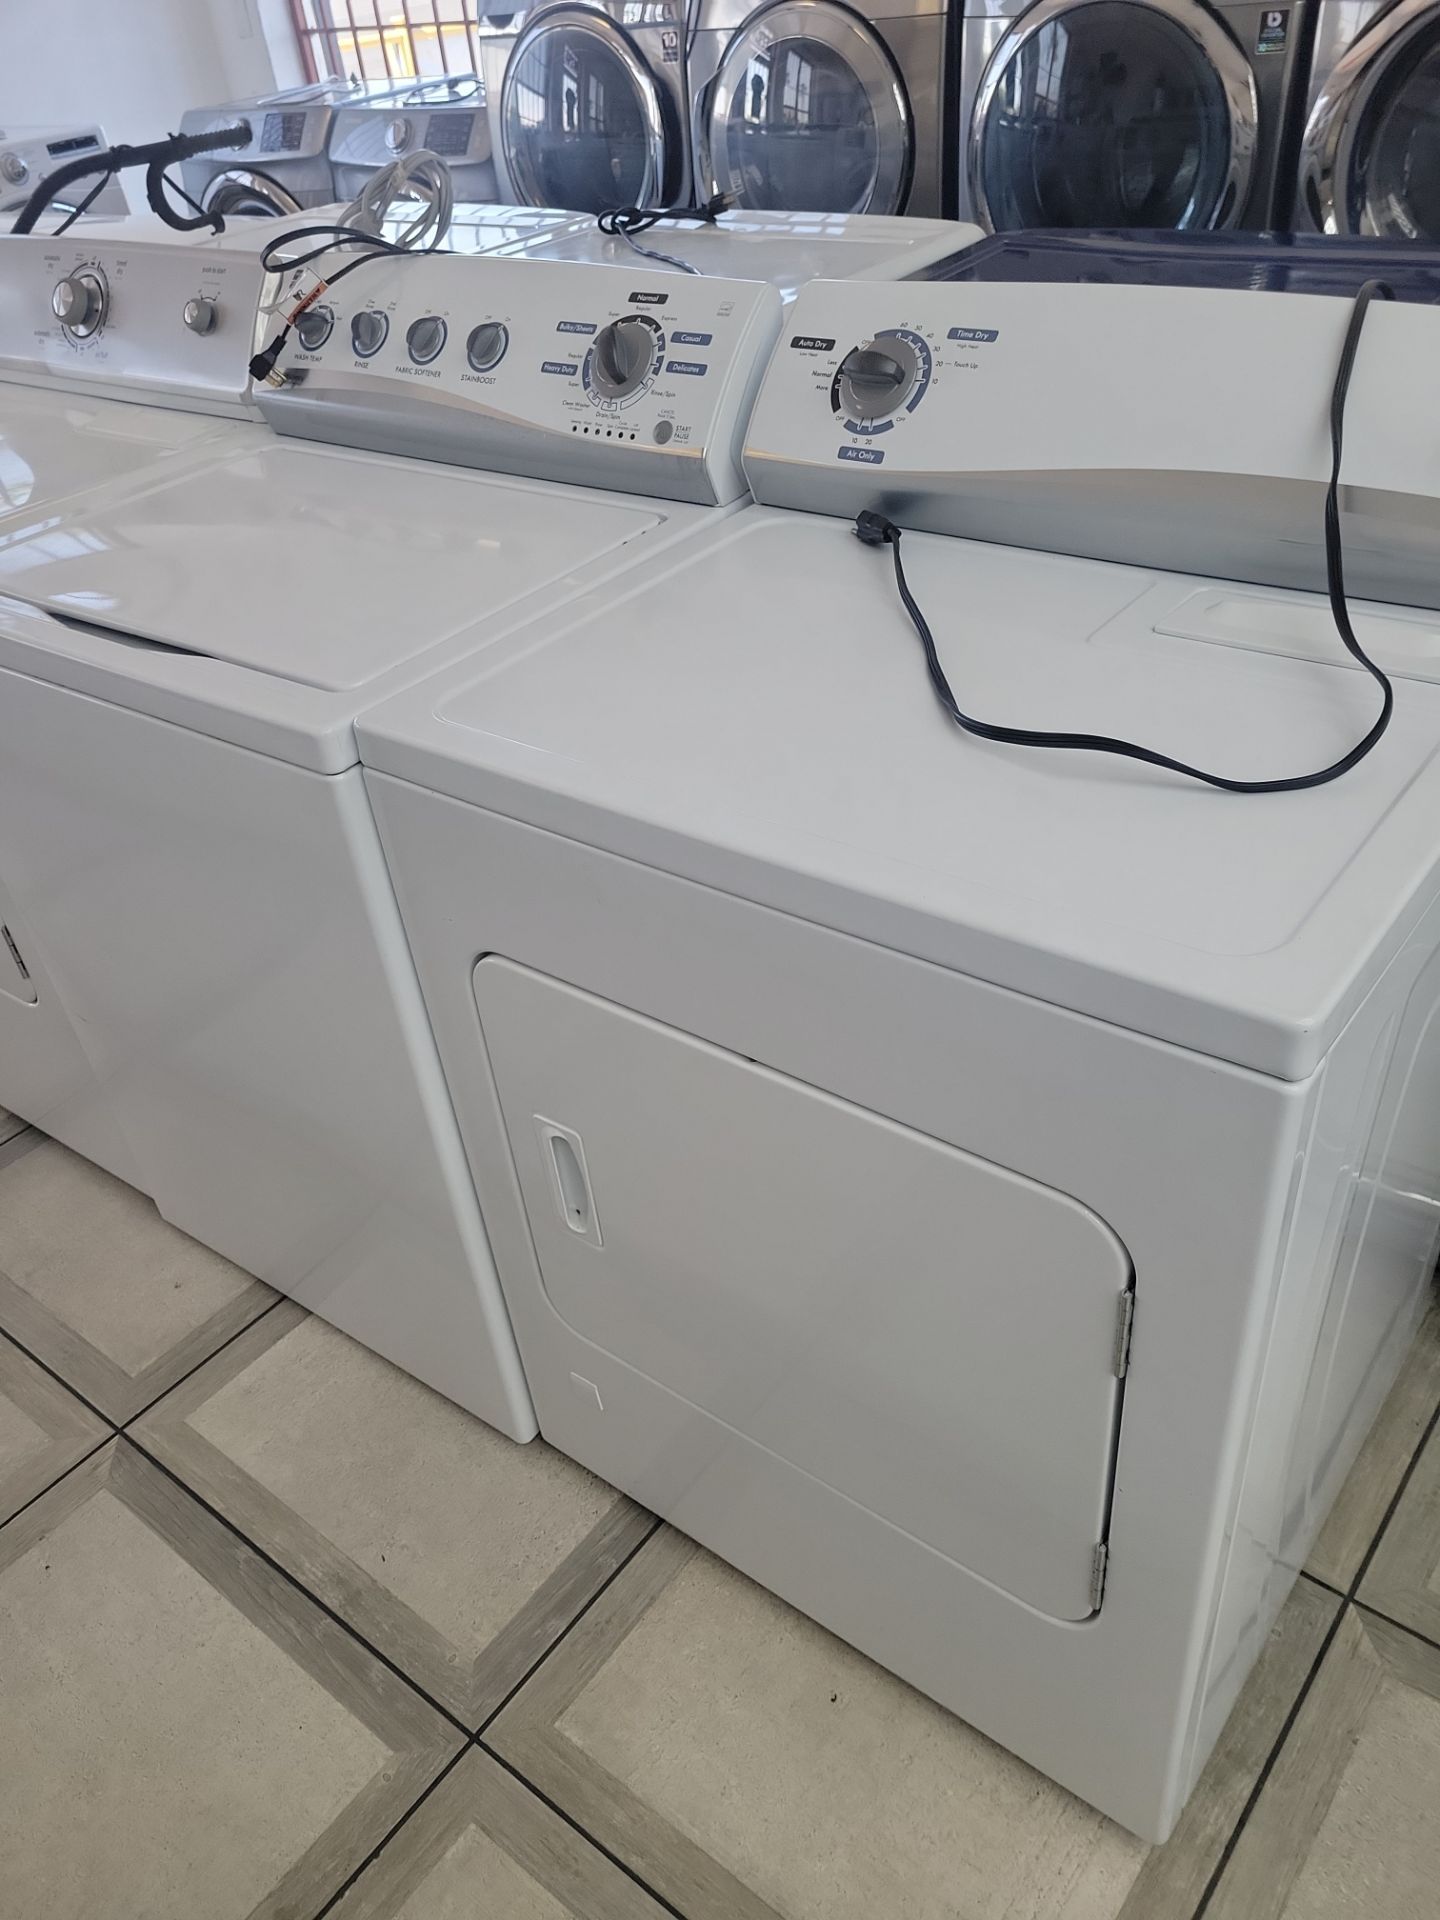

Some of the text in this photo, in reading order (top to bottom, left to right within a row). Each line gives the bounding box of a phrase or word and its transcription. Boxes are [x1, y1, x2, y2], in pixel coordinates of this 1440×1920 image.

[662, 33, 677, 47] 10
[636, 294, 660, 302] Normal
[559, 322, 594, 333] Bulky/Sheets
[680, 334, 702, 343] Casual
[957, 330, 989, 340] Time Dry
[798, 339, 828, 349] Auto Dry
[294, 353, 322, 362] WASH TEMP
[354, 360, 369, 369] RINSE
[543, 364, 575, 374] Heavy Duty
[672, 363, 700, 373] Delicates
[395, 366, 442, 378] FABRIC SOFTENER
[812, 370, 833, 378] Normal
[460, 374, 497, 385] STAINBOOST
[650, 390, 677, 398] Rinse/Spin
[595, 411, 621, 420] Drain/Spin
[846, 450, 875, 461] Air Only
